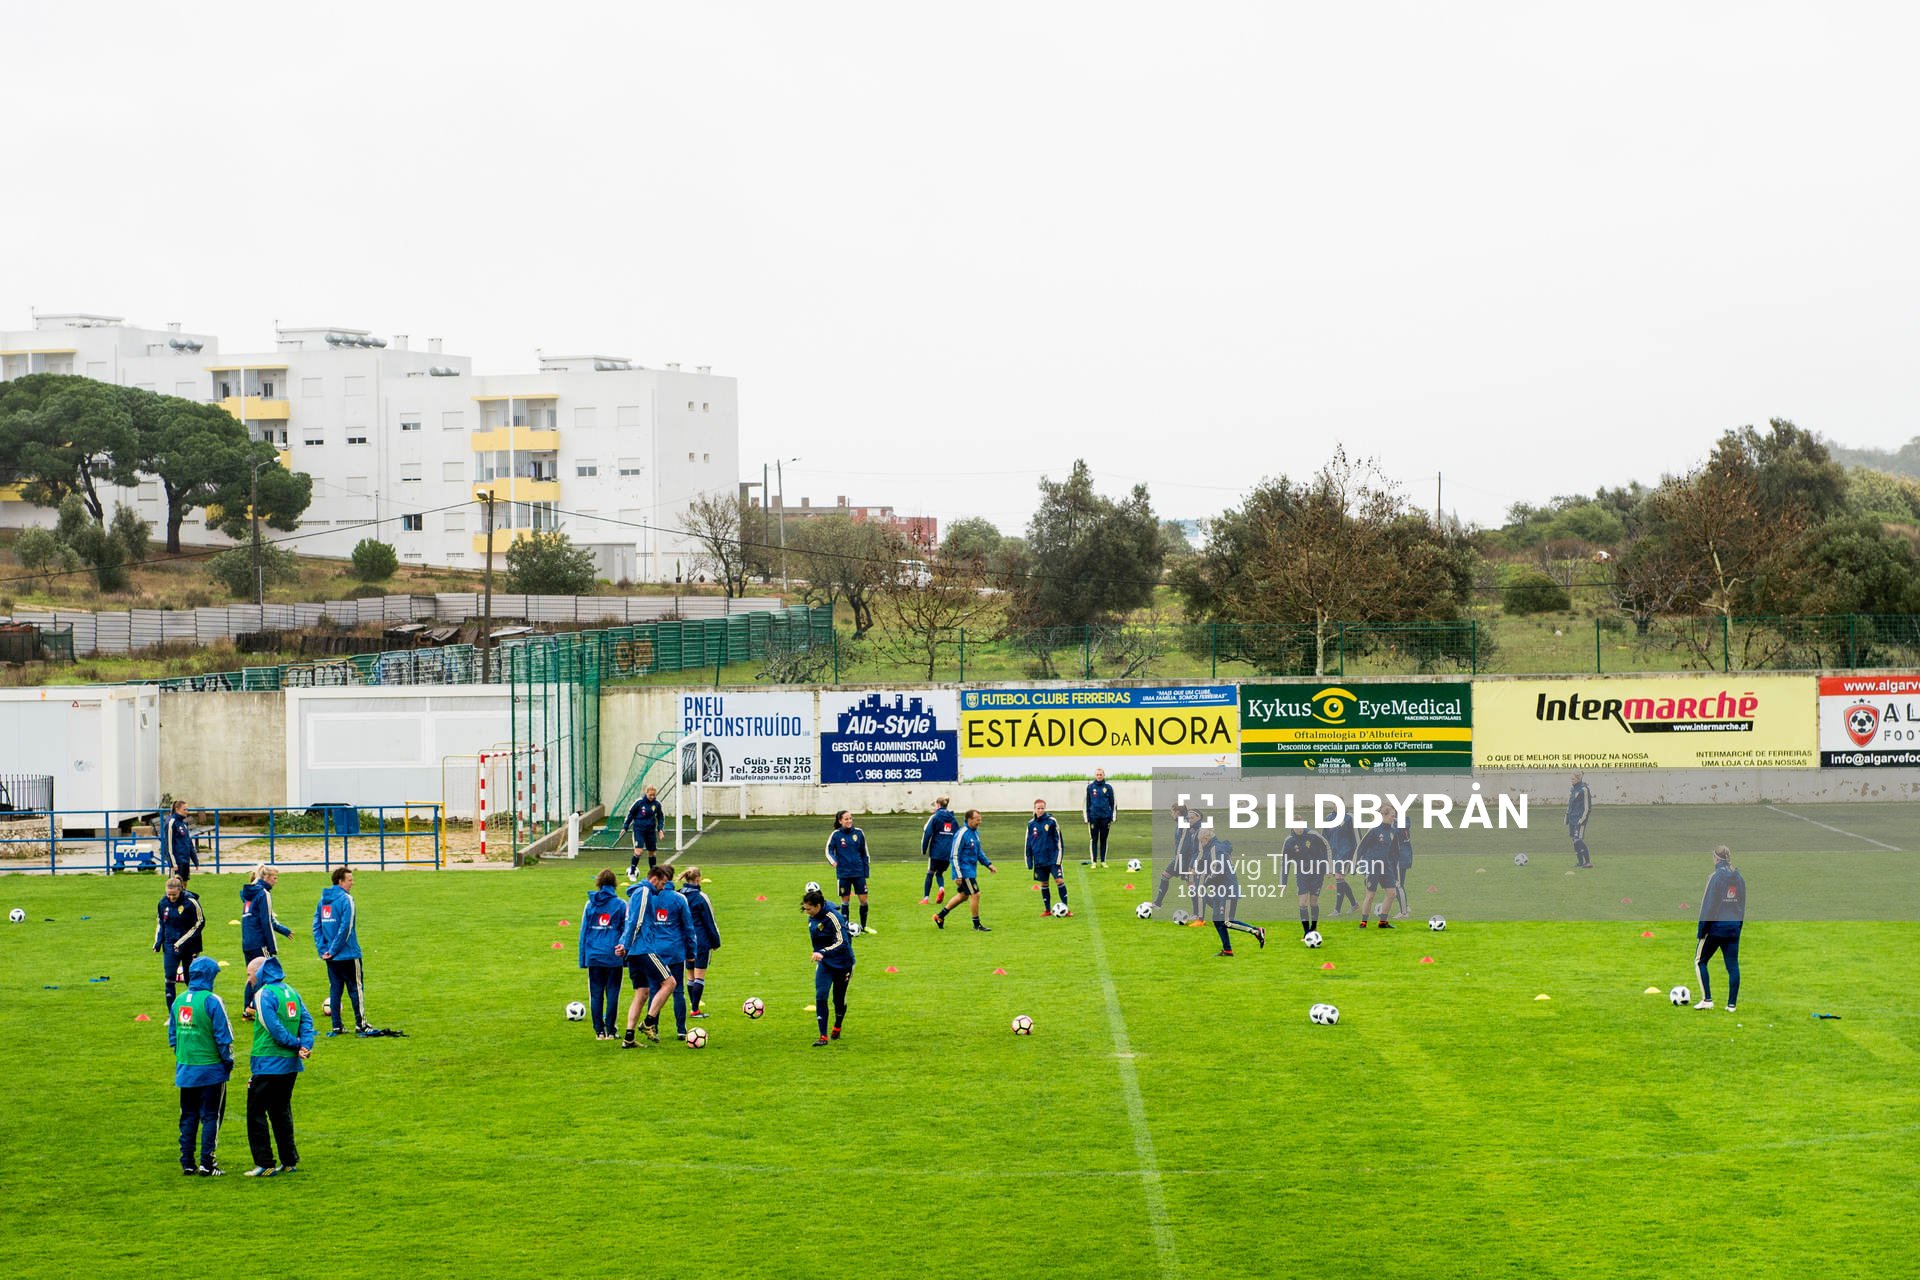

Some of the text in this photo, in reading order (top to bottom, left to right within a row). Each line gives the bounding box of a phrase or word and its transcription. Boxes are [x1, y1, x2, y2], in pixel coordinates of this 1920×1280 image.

[1844, 680, 1920, 692] www.algarv
[981, 692, 1131, 706] FUTEBOL CLUBE FERREIRAS
[684, 696, 723, 716] PNEU
[1248, 698, 1462, 722] Kykus EyeMedical
[684, 712, 801, 736] RECONSTRUÍDO
[845, 715, 930, 738] Alb-Style
[968, 712, 1232, 748] ESTÁDIO DA NORA
[1673, 723, 1749, 732] www.intermarche.pt
[1294, 730, 1414, 740] Oftalmologia D'Albufeira
[1884, 730, 1920, 741] FOO
[832, 739, 946, 752] GESTÃO E ADMINISTRAÇÃO
[1313, 743, 1343, 752] especiais
[744, 757, 767, 765] Guia
[842, 752, 938, 764] DE CONDOMINIOS, LDA
[865, 769, 922, 779] 966 865 325
